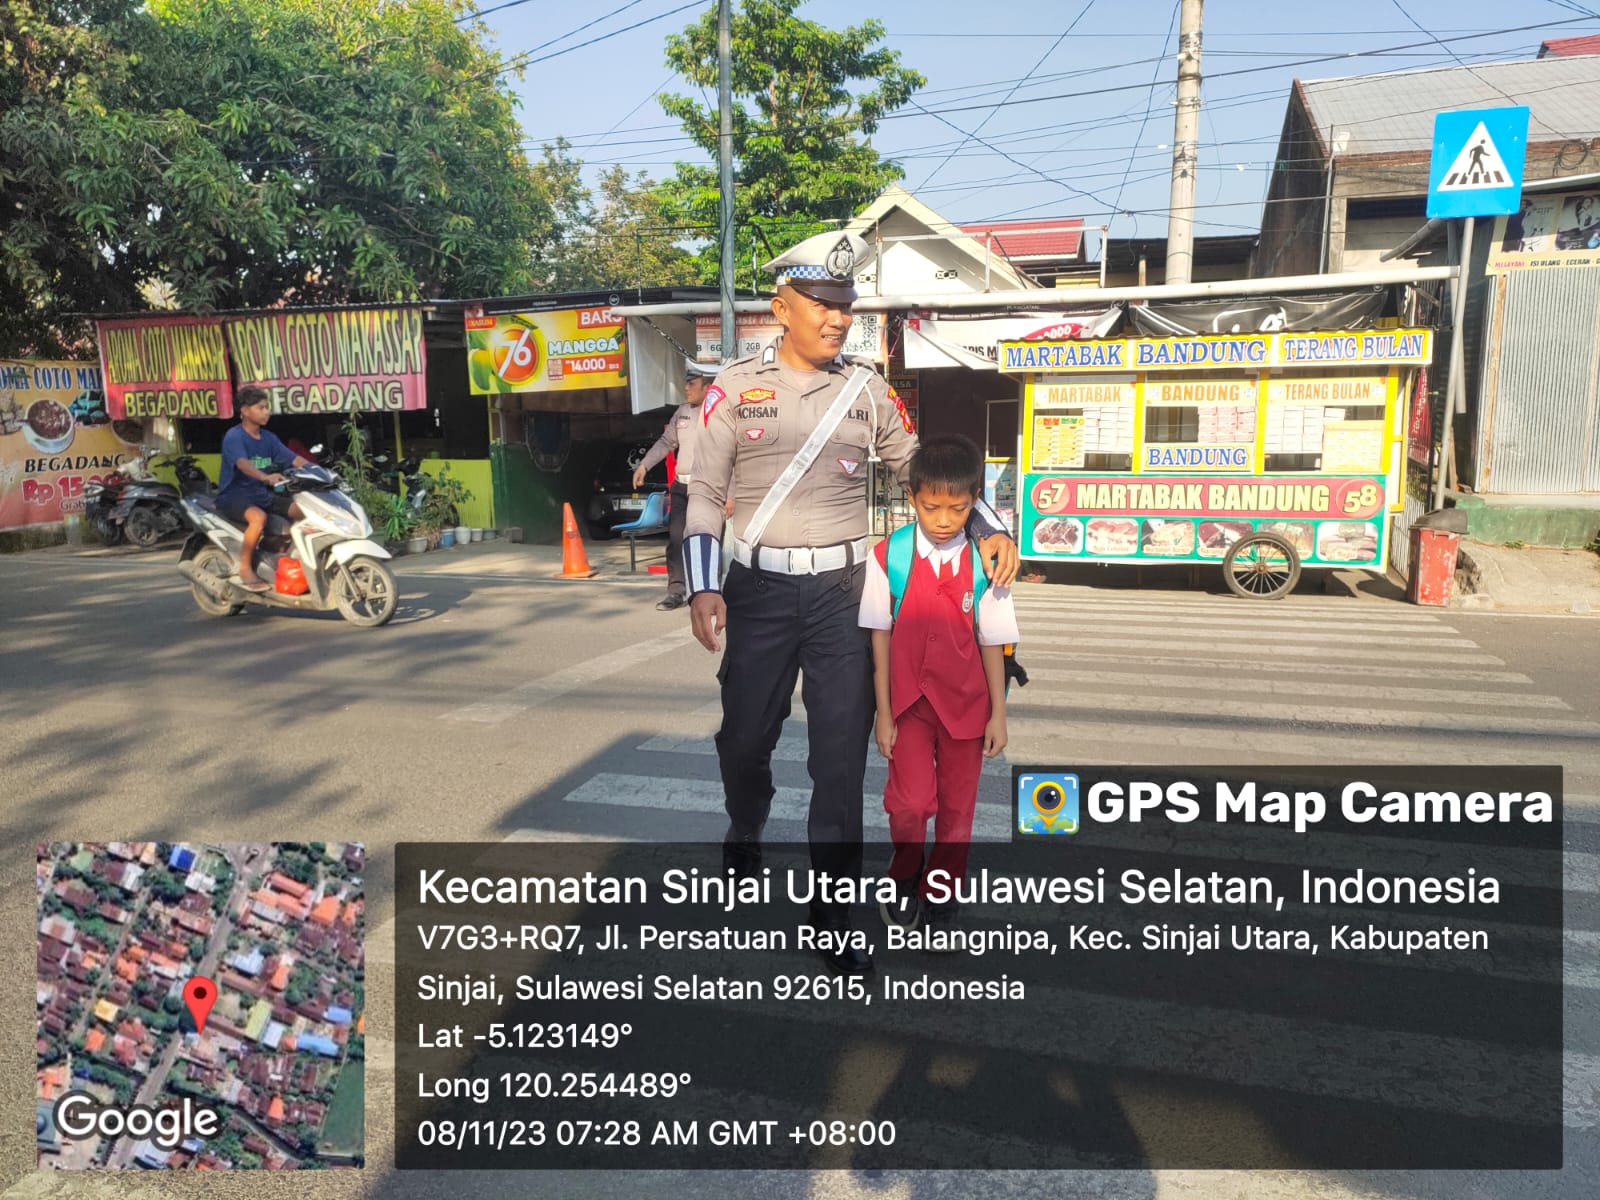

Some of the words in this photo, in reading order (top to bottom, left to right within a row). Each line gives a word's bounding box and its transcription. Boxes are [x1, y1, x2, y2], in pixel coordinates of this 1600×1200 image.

[141, 325, 172, 382] COTO
[286, 313, 334, 378] COTO
[334, 308, 422, 376] MAKASSAR
[491, 328, 532, 378] 76
[548, 337, 619, 356] MANGGA
[1006, 344, 1122, 368] MARTABAK
[1137, 340, 1266, 365] BANDUNG
[1284, 337, 1357, 361] TERANG
[1362, 334, 1424, 358] BULAN
[34, 367, 72, 390] COTO
[124, 390, 218, 417] BEGADANG
[1048, 386, 1121, 403] MARTABAK
[1162, 385, 1240, 401] BANDUNG
[1285, 384, 1328, 400] TERANG
[1333, 383, 1370, 399] BULAN
[737, 407, 778, 419] ACHSAN
[25, 454, 125, 473] BEGADANG
[1149, 448, 1247, 466] BANDUNG
[22, 479, 54, 506] Rp
[1038, 483, 1066, 509] 57
[1076, 483, 1203, 510] MARTABAK
[1208, 484, 1330, 512] BANDUNG
[1343, 484, 1377, 513] 58
